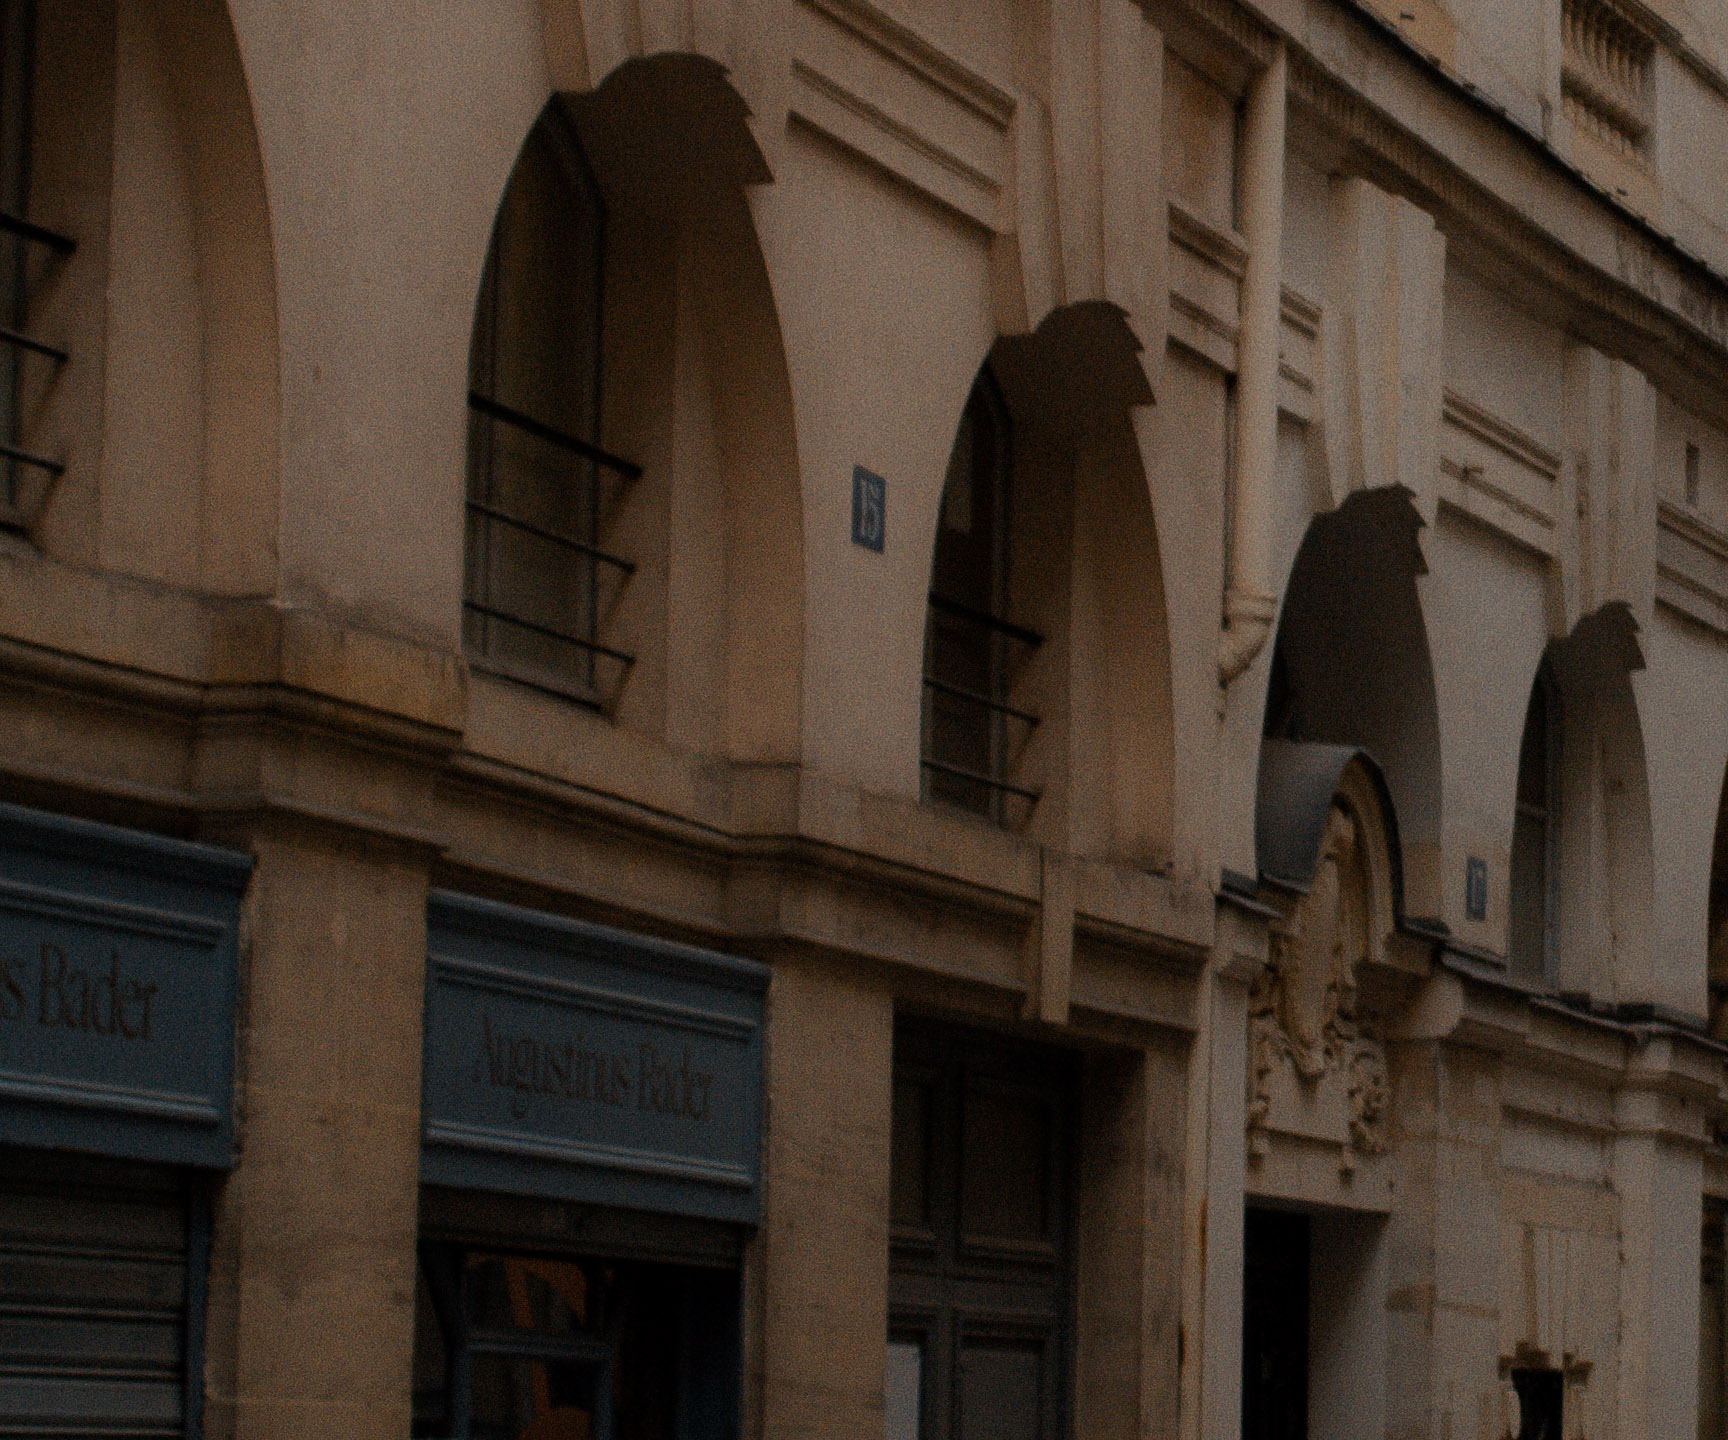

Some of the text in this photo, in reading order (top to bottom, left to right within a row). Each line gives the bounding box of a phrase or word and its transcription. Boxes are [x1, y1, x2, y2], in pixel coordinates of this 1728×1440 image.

[858, 477, 881, 543] 15
[38, 942, 159, 1042] Bader
[472, 1016, 714, 1121] Augustinus Bader
